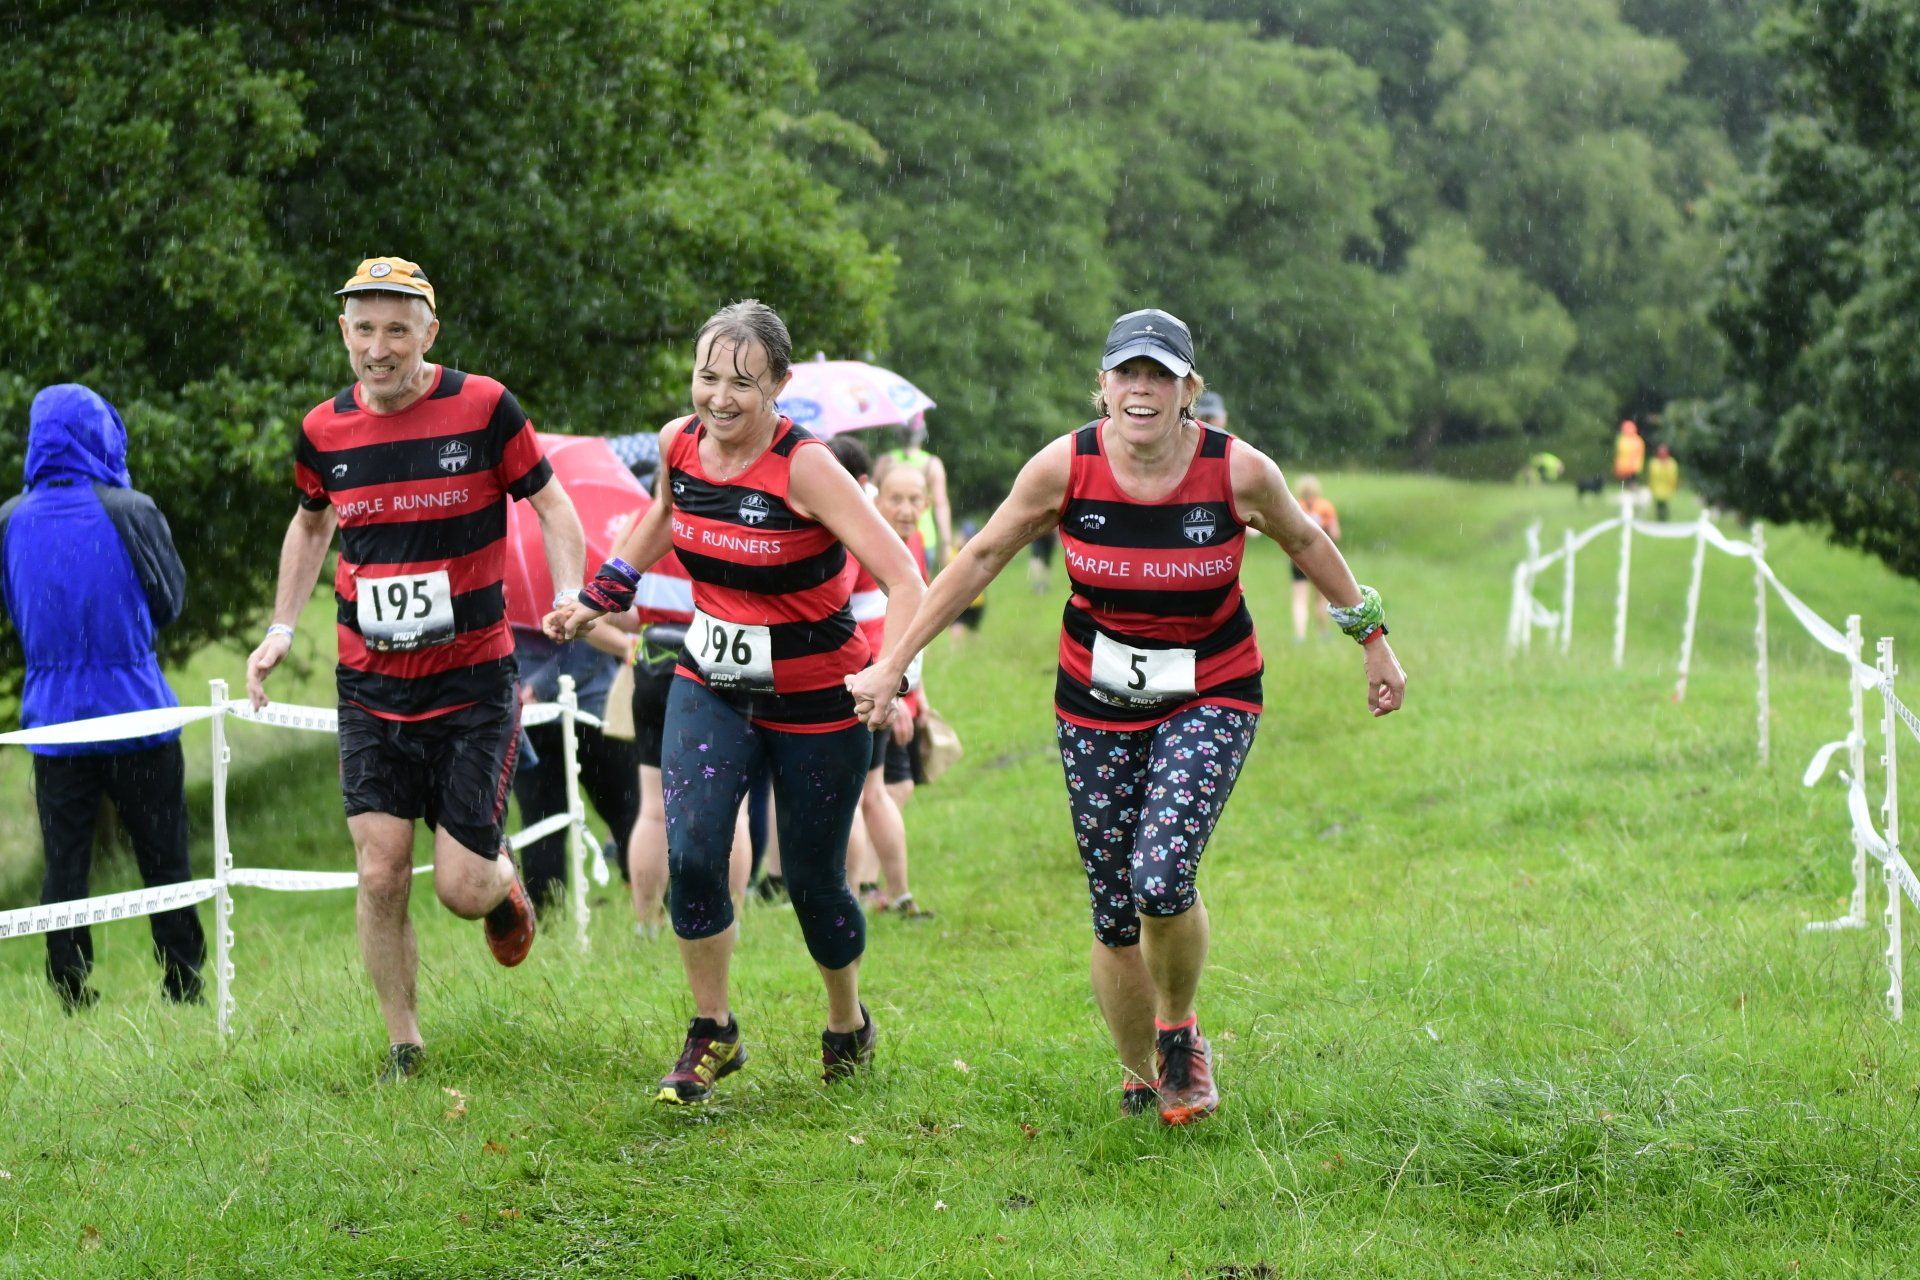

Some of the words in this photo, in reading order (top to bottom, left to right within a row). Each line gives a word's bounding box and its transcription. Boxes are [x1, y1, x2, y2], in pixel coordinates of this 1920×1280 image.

[393, 488, 469, 511] RUNNERS
[671, 517, 694, 540] RPLE
[702, 530, 781, 554] RUNNERS
[1084, 522, 1100, 530] JALB
[1066, 547, 1131, 577] MARPLE
[1143, 555, 1233, 578] RUNNERS
[372, 579, 432, 621] 195
[700, 619, 752, 665] 196
[1128, 653, 1147, 690] 5
